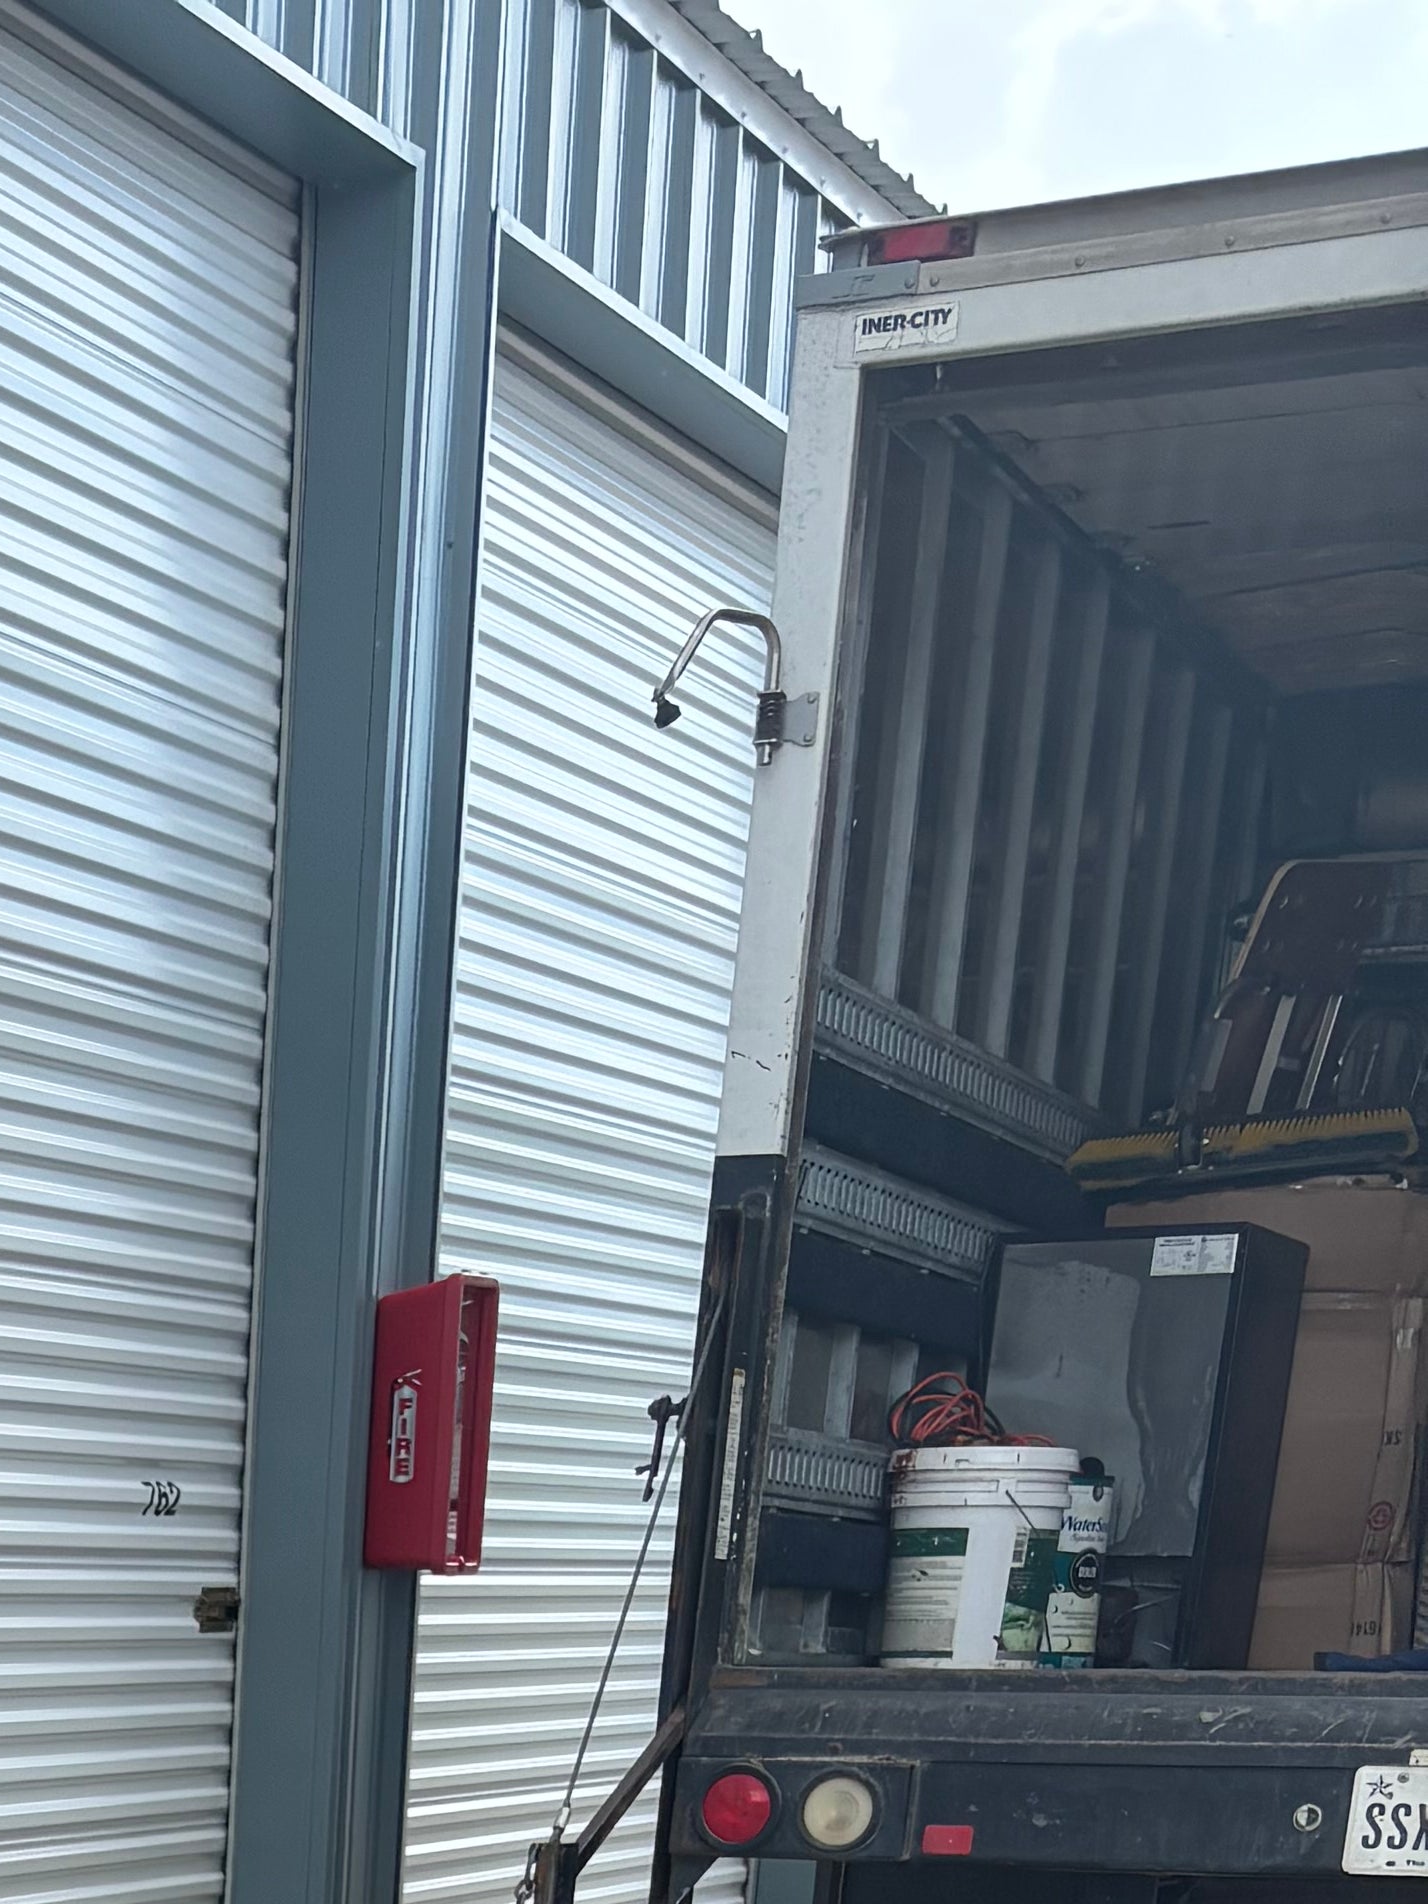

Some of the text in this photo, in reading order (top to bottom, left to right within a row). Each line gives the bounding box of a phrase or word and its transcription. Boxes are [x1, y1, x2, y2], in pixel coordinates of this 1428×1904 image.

[861, 308, 953, 336] INER-CITY
[395, 1397, 414, 1476] FIRE
[140, 1481, 181, 1517] 762
